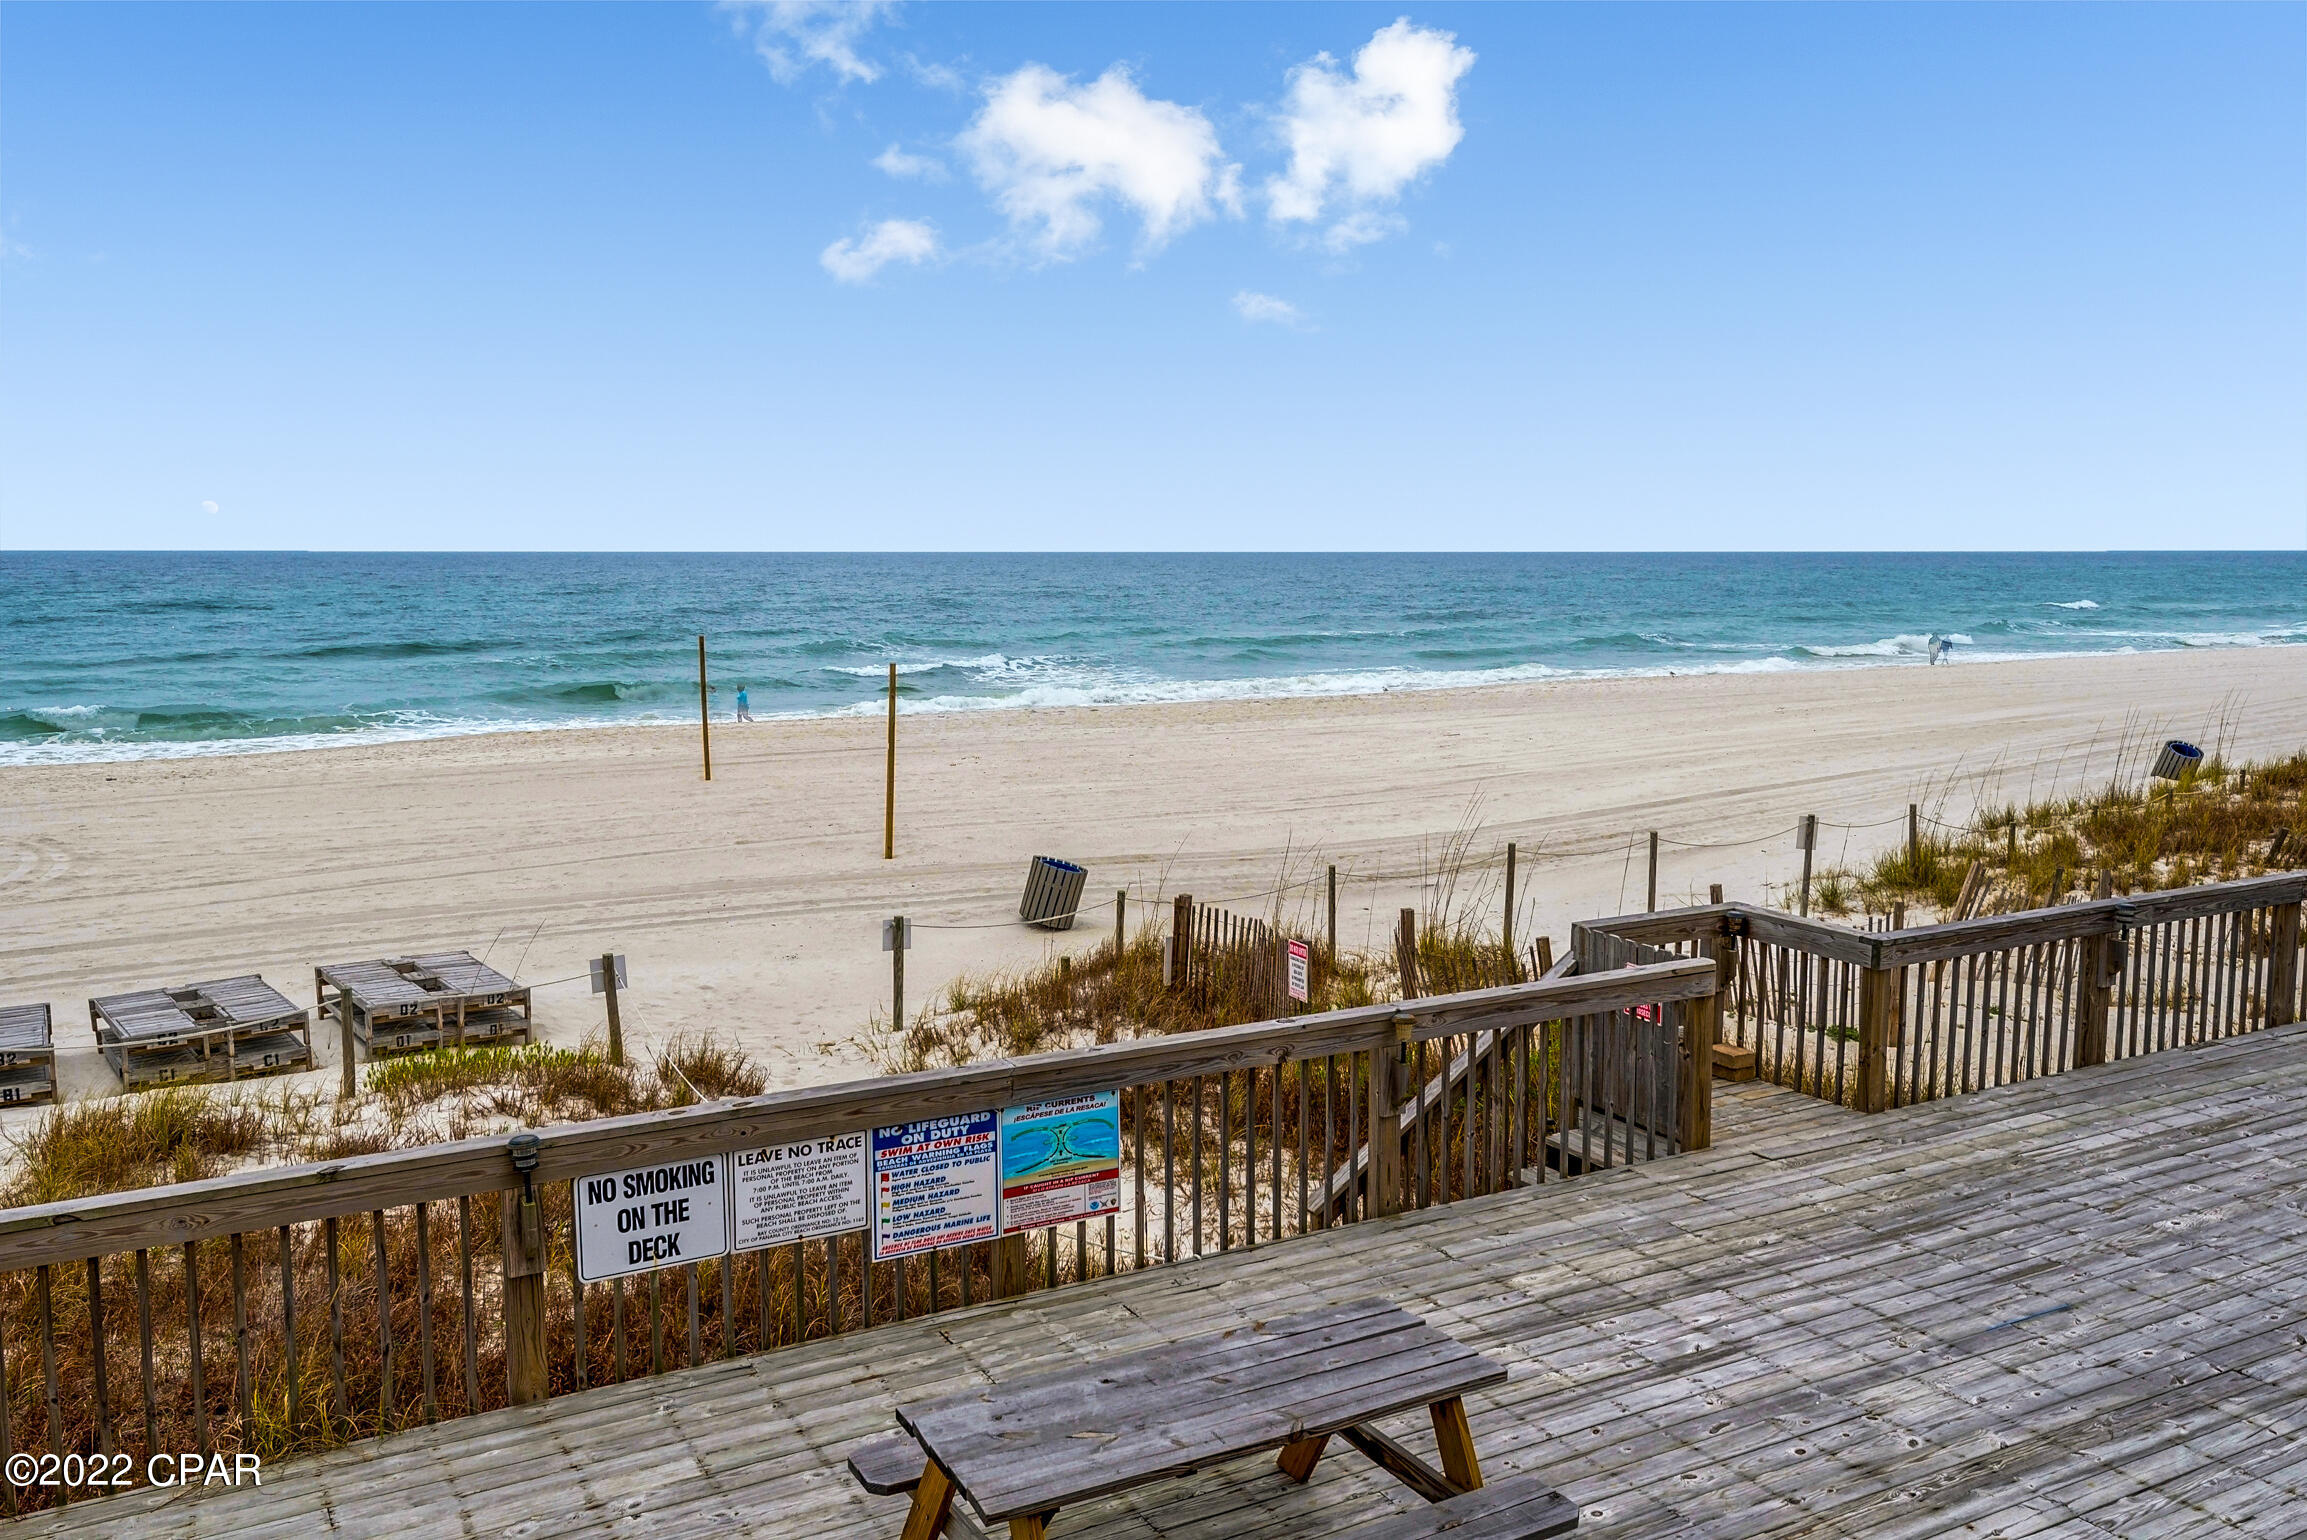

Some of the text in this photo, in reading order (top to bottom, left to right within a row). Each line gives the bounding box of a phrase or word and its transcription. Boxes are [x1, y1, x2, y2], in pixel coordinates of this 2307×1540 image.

[1045, 1095, 1096, 1108] CURRENTS
[1066, 1106, 1075, 1114] LA
[879, 1112, 991, 1139] NO LIFEGUARD
[901, 1125, 969, 1144] ON DUTY
[738, 1136, 862, 1167] LEAVE NO TRACE
[877, 1142, 993, 1167] BEACH WARNING FLAGS
[881, 1133, 989, 1158] SWIM AT OWN RISK
[742, 1174, 773, 1183] PERSONAL
[775, 1168, 805, 1177] PROPERTY
[832, 1159, 859, 1168] PORTION
[758, 1164, 792, 1174] UNLAWFUL
[803, 1159, 821, 1167] LEAVE
[794, 1172, 814, 1180] BEACH
[816, 1169, 833, 1177] FROM
[891, 1168, 918, 1178] WATER
[921, 1163, 949, 1173] CLOSED
[965, 1156, 991, 1166] PUBLIC
[587, 1160, 715, 1206] NO SMOKING
[768, 1184, 780, 1192] P.M.
[782, 1181, 800, 1189] UNTIL
[831, 1172, 849, 1181] DAILY.
[891, 1183, 911, 1192] HIGH
[914, 1176, 946, 1187] HAZARD
[1030, 1181, 1051, 1189] CAUGHT
[763, 1190, 797, 1200] UNLAWFUL
[809, 1185, 826, 1193] LEAVE
[764, 1197, 796, 1206] PERSONAL
[797, 1192, 826, 1200] PROPERTY
[827, 1187, 849, 1196] WITHIN
[892, 1196, 925, 1206] MEDIUM
[928, 1189, 960, 1199] HAZARD
[775, 1203, 796, 1211] PUBLIC
[798, 1199, 818, 1207] BEACH
[820, 1195, 843, 1203] ACCESS.
[617, 1198, 690, 1234] ON THE
[742, 1218, 760, 1226] SUCH
[761, 1213, 792, 1222] PERSONAL
[793, 1207, 823, 1216] PROPERTY
[757, 1221, 777, 1229] BEACH
[807, 1210, 836, 1220] DISPOSED
[892, 1213, 909, 1222] LOW
[913, 1207, 946, 1218] HAZARD
[791, 1221, 821, 1230] ORDINANCE
[812, 1222, 841, 1231] ORDINANCE
[893, 1224, 941, 1239] DANGEROUS
[944, 1218, 974, 1229] MARINE
[976, 1214, 991, 1223] LIFE
[628, 1232, 681, 1265] DECK
